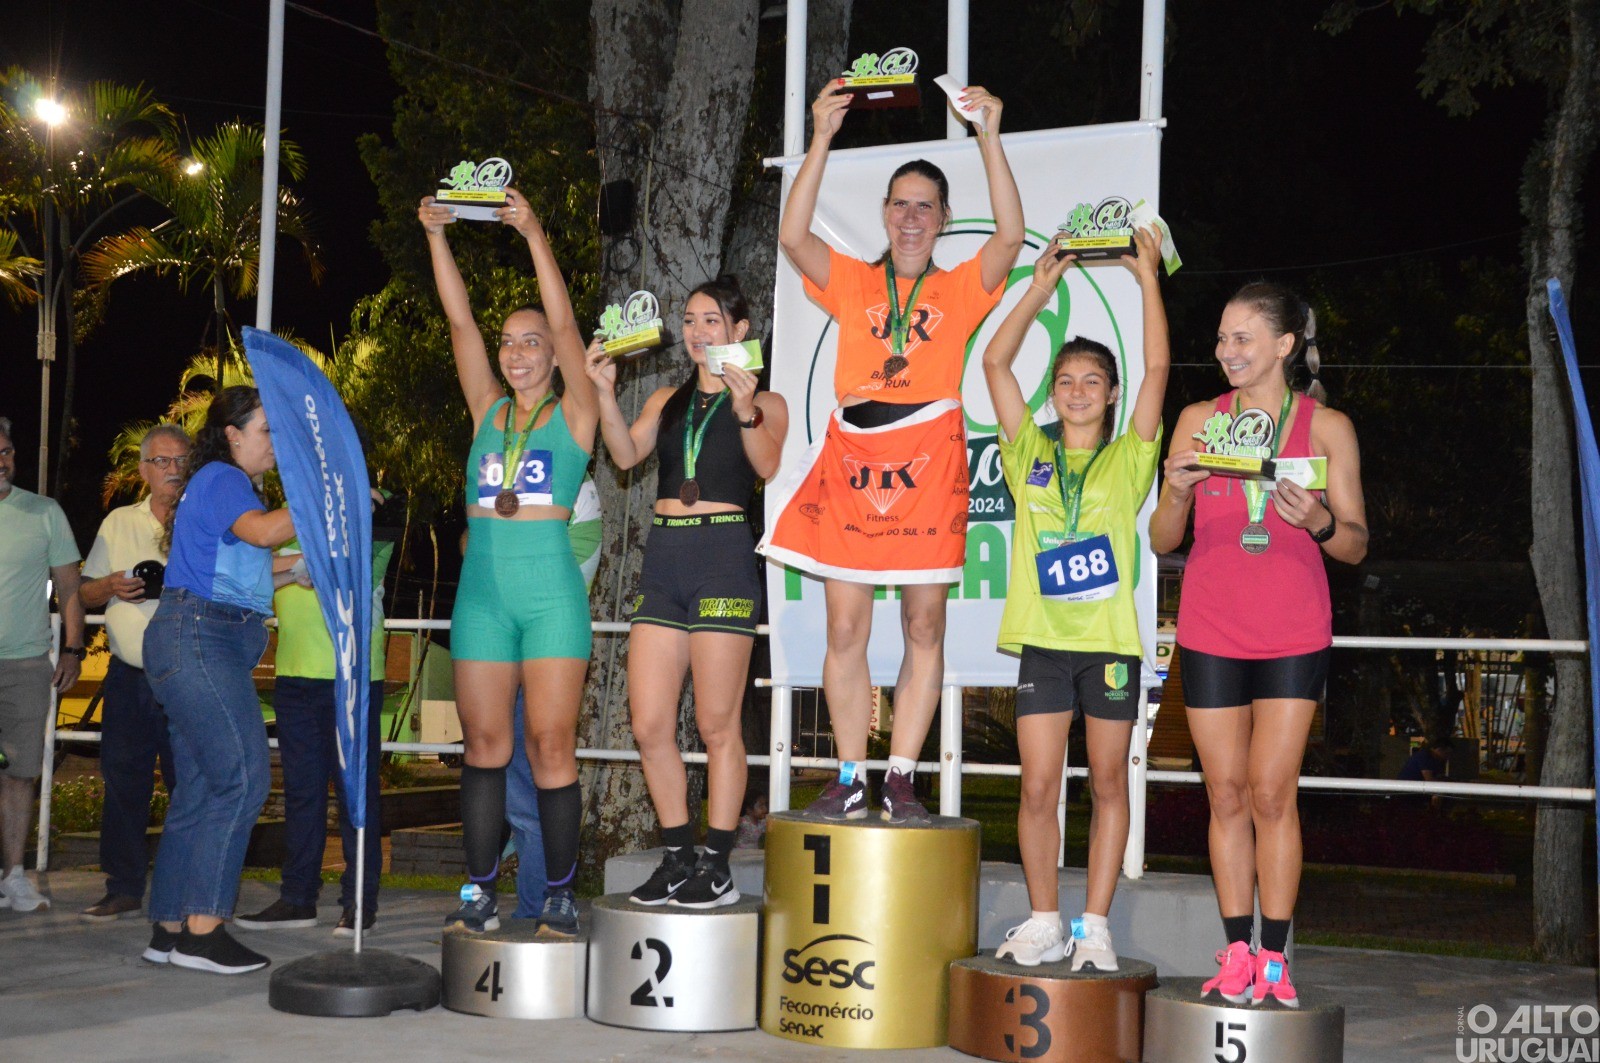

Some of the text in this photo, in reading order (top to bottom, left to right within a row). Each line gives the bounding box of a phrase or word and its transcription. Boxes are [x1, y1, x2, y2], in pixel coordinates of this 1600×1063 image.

[884, 379, 911, 389] RUN
[968, 497, 1006, 513] 2024
[666, 517, 702, 527] TRINCKS
[710, 514, 745, 524] TRINCKS
[866, 514, 899, 522] Fitness
[886, 528, 900, 536] DO
[902, 527, 918, 536] SUL
[927, 527, 937, 536] RS
[1048, 549, 1110, 586] 188
[698, 597, 754, 611] TRINCKS
[699, 609, 751, 618] SPORTSWEAR
[804, 834, 831, 924] 1
[475, 961, 503, 1002] 4
[630, 938, 674, 1008] 2
[779, 996, 874, 1020] Fecomércio
[779, 1017, 824, 1038] Senac
[1004, 983, 1052, 1059] 3
[1214, 1020, 1247, 1063] 5
